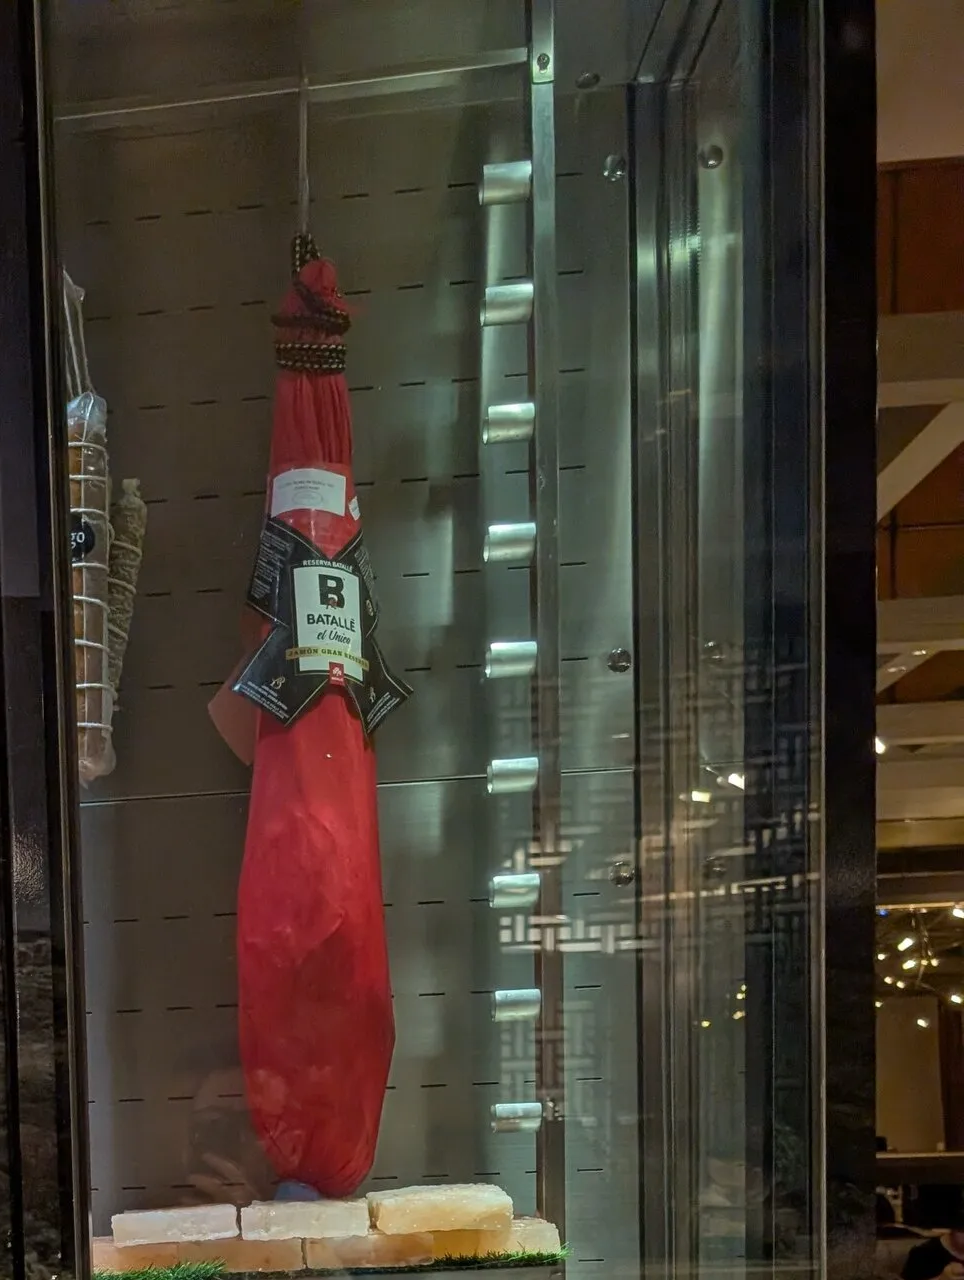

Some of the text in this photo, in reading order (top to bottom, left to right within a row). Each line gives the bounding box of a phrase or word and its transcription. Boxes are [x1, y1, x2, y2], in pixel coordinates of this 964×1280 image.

[319, 574, 345, 609] B
[317, 628, 351, 644] el Único
[321, 648, 343, 656] GRAN
